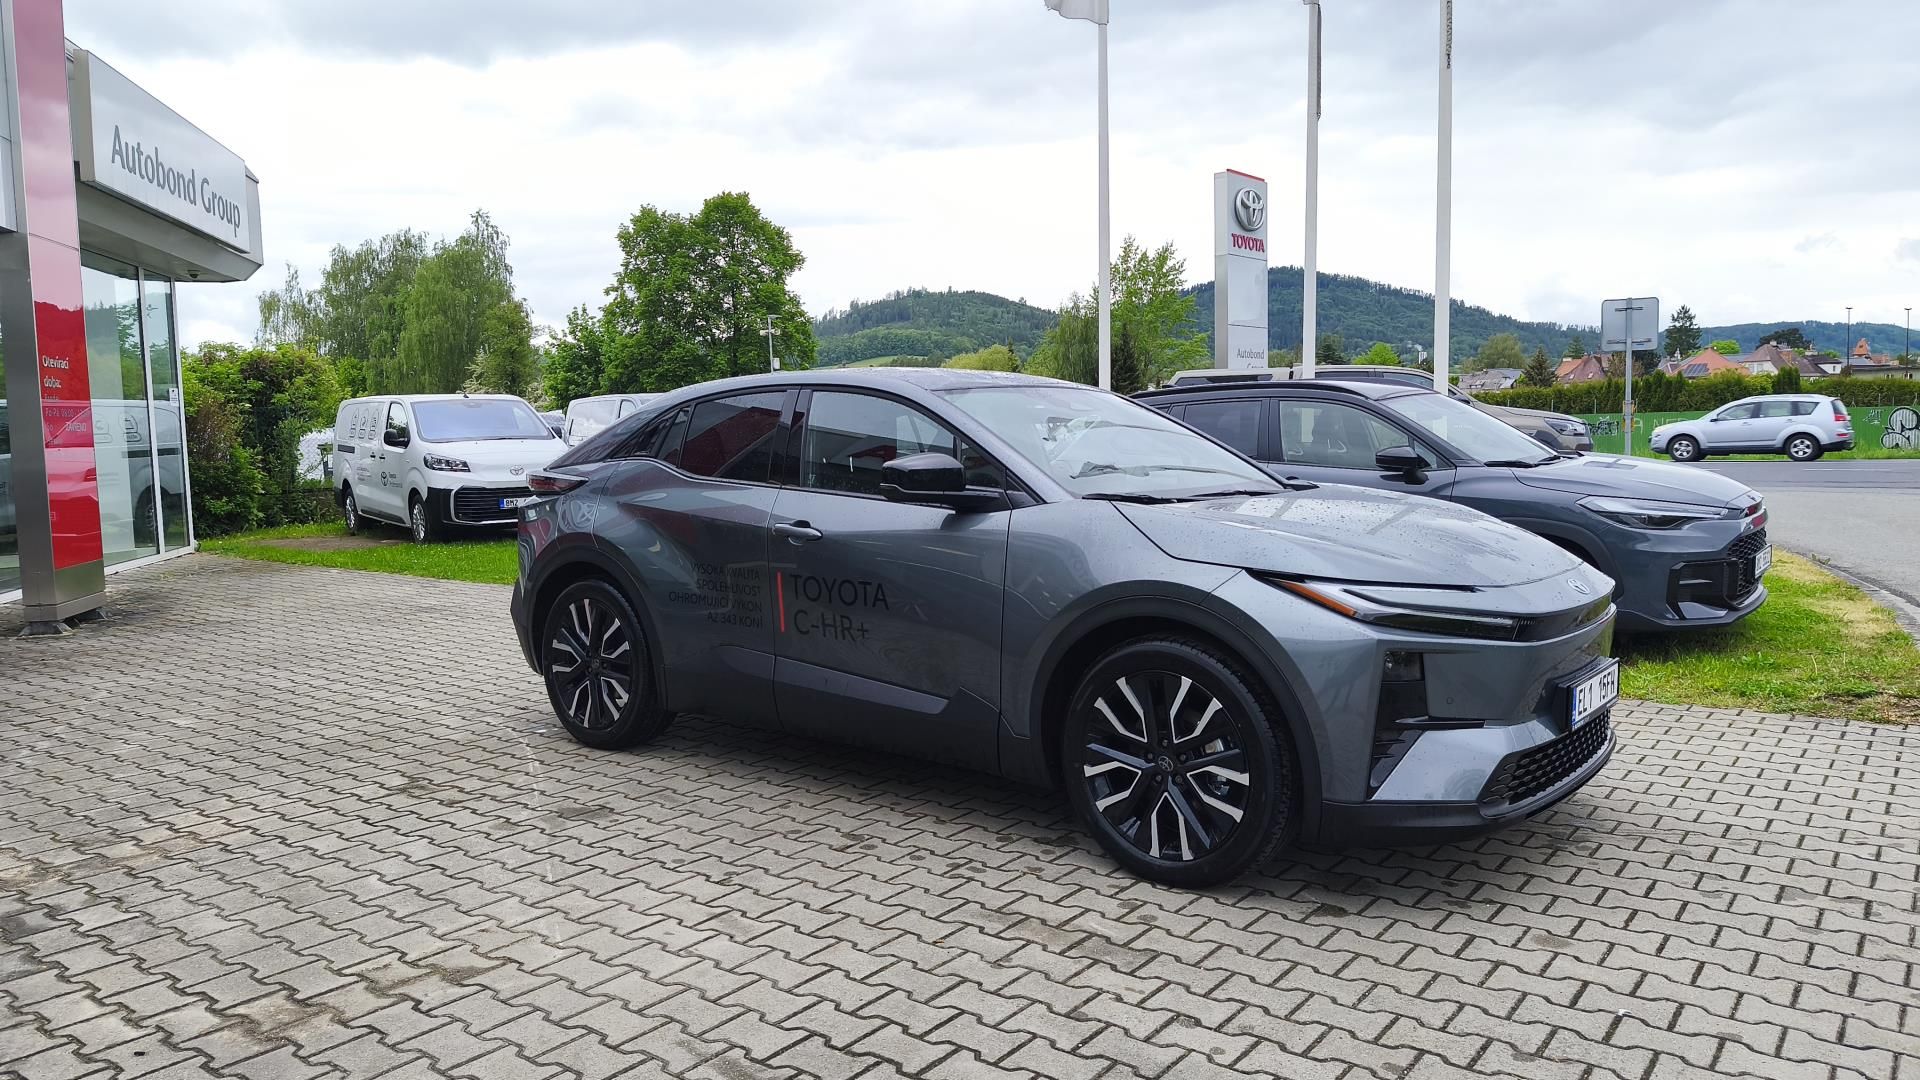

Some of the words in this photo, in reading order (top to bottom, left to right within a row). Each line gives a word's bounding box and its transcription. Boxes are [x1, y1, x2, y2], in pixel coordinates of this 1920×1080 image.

[112, 124, 197, 206] Autobond
[200, 177, 240, 238] Group
[1231, 233, 1265, 253] TOYOTA
[1237, 348, 1265, 360] Autobond
[789, 573, 890, 611] TOYOTA
[794, 609, 869, 642] C-HR+
